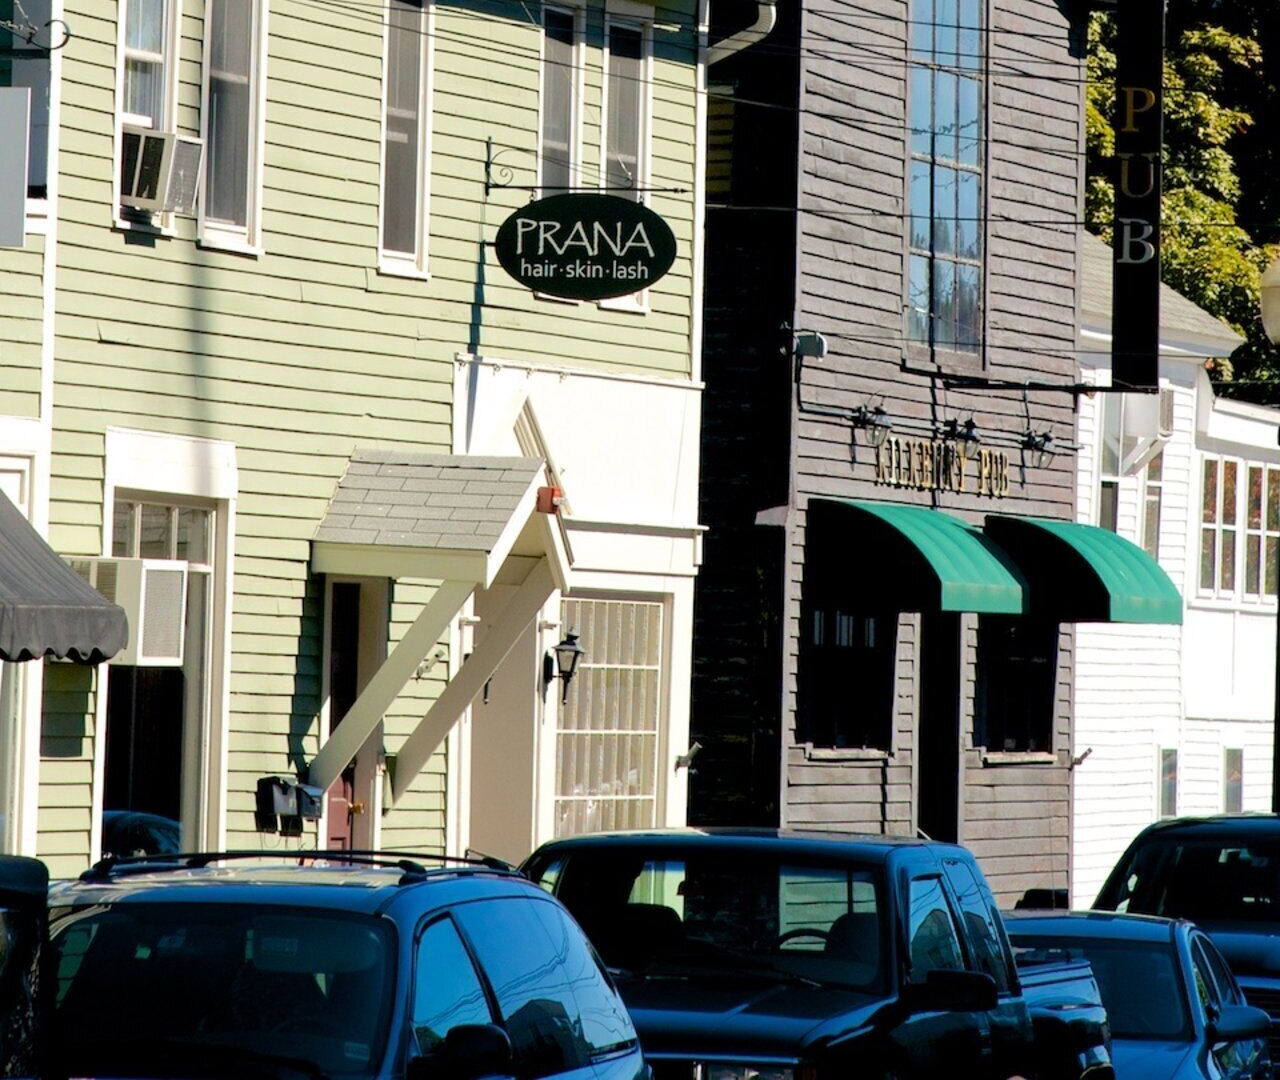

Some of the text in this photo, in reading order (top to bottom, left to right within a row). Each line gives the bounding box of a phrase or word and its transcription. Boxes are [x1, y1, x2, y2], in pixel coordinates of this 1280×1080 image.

[1117, 86, 1160, 264] PUB
[516, 218, 656, 258] PRANA
[980, 449, 1010, 497] PUB
